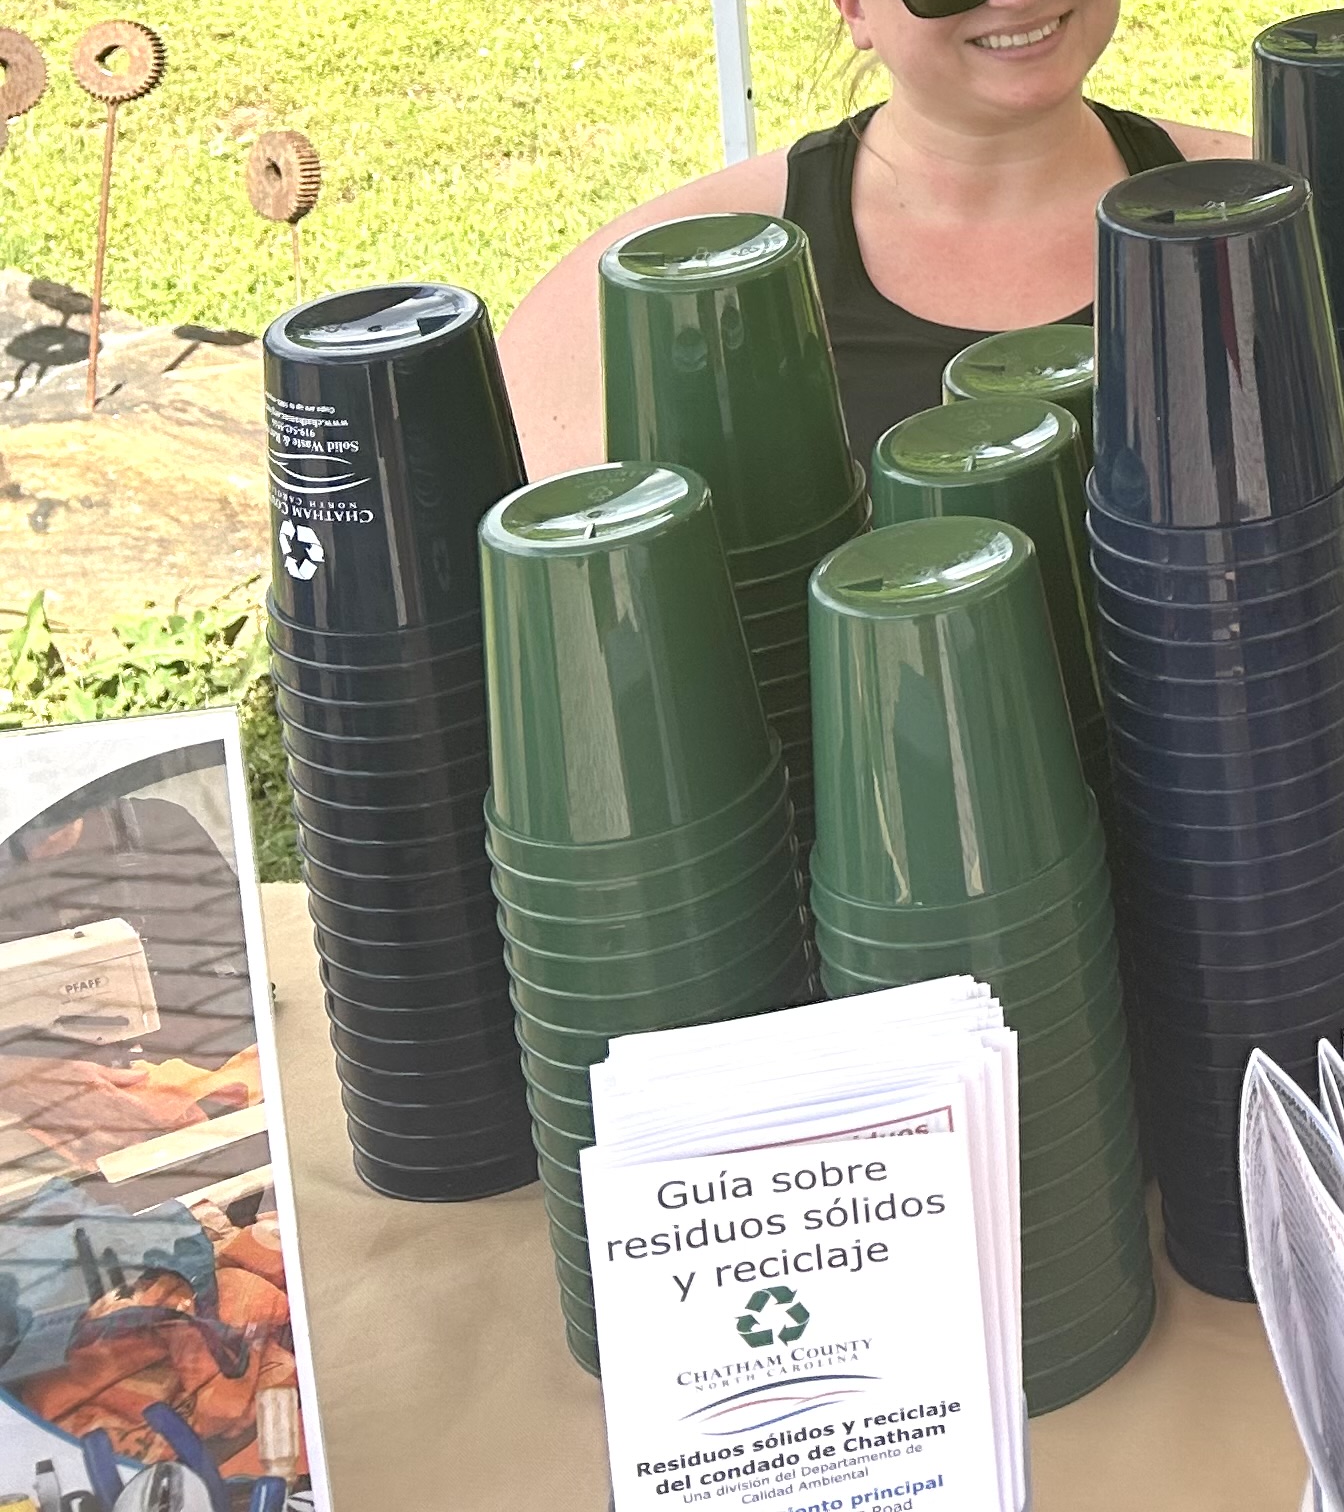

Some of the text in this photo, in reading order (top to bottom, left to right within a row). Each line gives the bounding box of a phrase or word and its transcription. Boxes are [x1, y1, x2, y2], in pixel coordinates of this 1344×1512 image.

[327, 440, 359, 453] Solid
[292, 507, 374, 523] CHATHAM
[65, 977, 101, 993] PFAFF
[656, 1156, 888, 1210] Guía sobre
[607, 1189, 946, 1261] residuos sólidos
[672, 1236, 890, 1302] y reciclaje
[676, 1339, 873, 1386] CHATHAM COUNTY
[695, 1353, 860, 1392] NORTH CAROLINA
[636, 1400, 961, 1478] Residuos sólidos y reciclaje
[656, 1423, 946, 1495] del condado de Chatham
